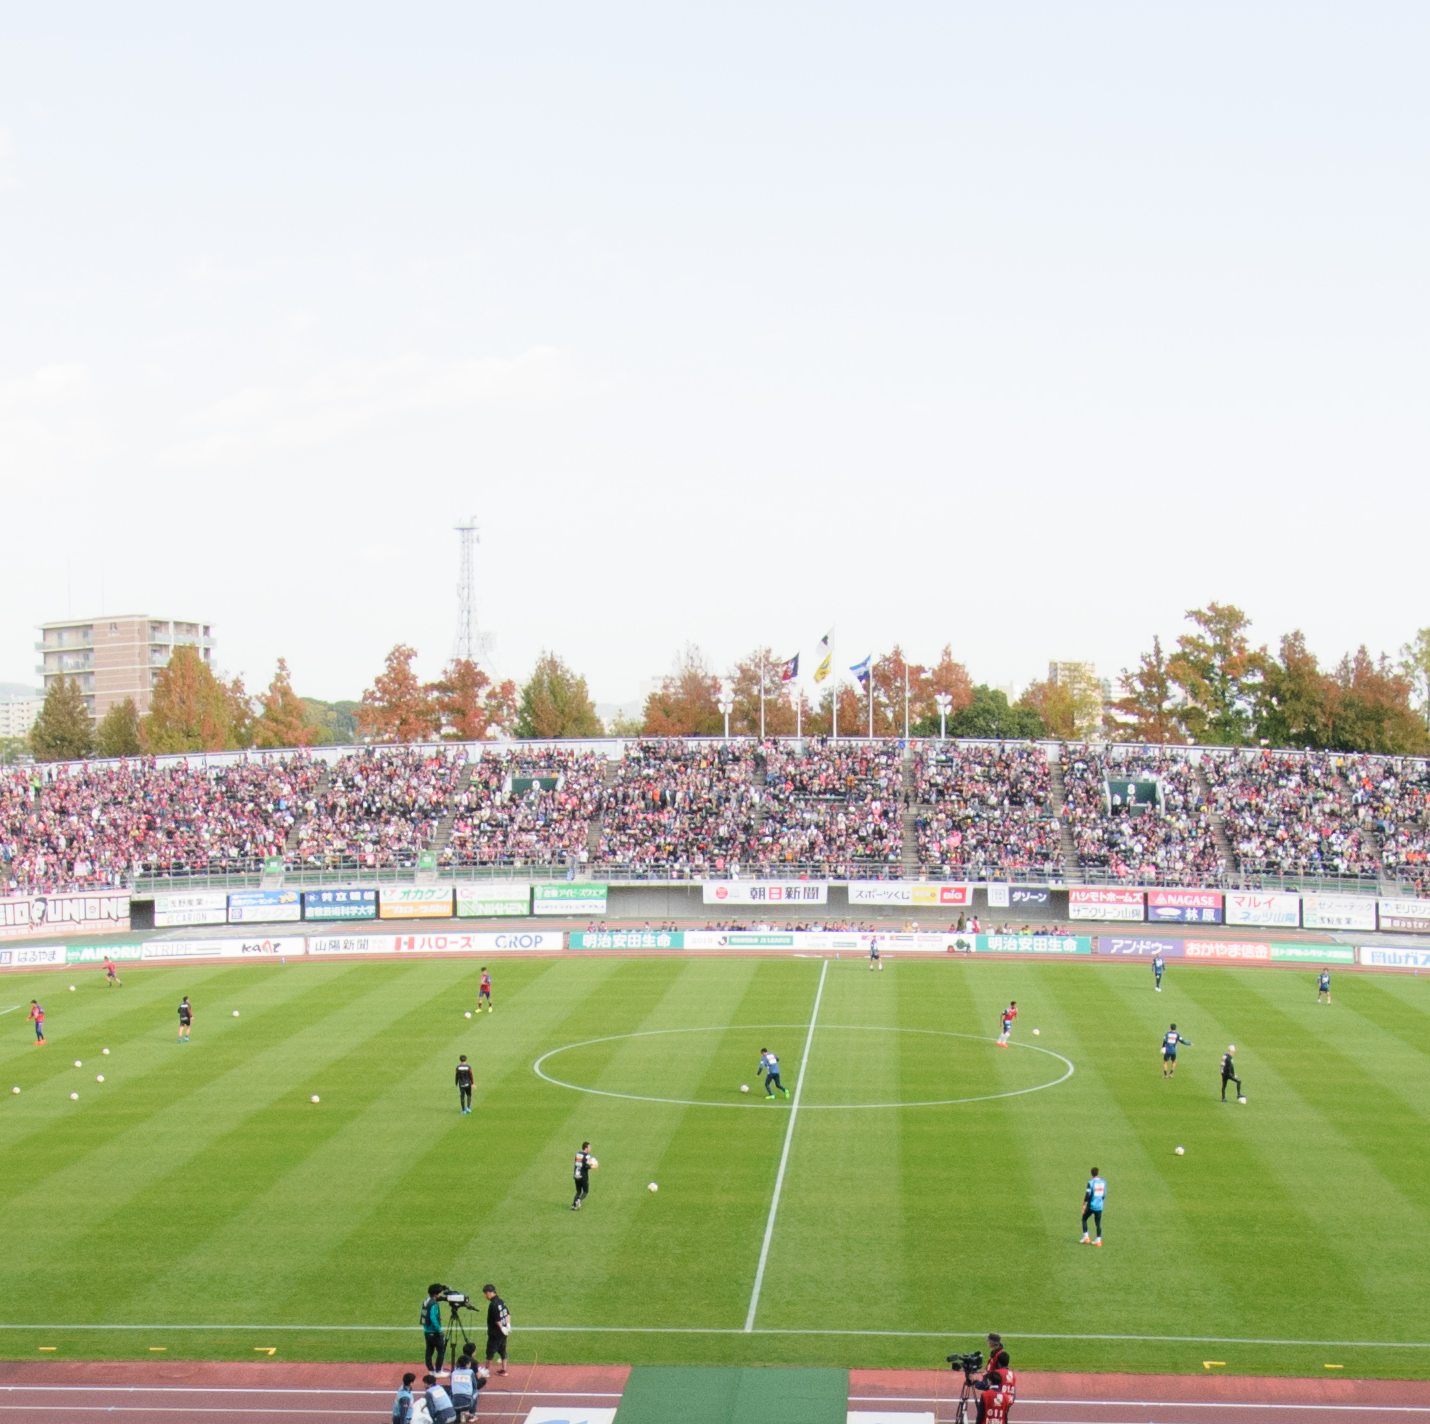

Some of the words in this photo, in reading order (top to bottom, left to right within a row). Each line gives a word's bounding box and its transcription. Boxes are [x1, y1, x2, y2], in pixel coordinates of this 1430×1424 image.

[749, 886, 820, 900] 朝日新聞
[854, 888, 911, 900] スポーツくじ
[942, 888, 963, 899] BIG
[1011, 890, 1048, 902] ダゾーン
[1167, 894, 1215, 907] NAGASE
[1233, 896, 1274, 909] マルイ
[48, 896, 131, 922] UNIONE
[479, 901, 529, 915] NIKKEN
[176, 912, 208, 923] CARION
[1185, 908, 1216, 922] 林原
[314, 939, 370, 951] 山陽新聞
[418, 937, 473, 949] ハローズ
[495, 934, 544, 949] GROP
[582, 931, 672, 948] 明治安田生命
[987, 936, 1077, 953] 明治安田生命
[17, 950, 57, 963] はるやま
[79, 945, 141, 961] MINORU
[144, 943, 193, 958] STRIPE
[1185, 942, 1270, 959] おかやま信金
[987, 1408, 1004, 1417] 011
